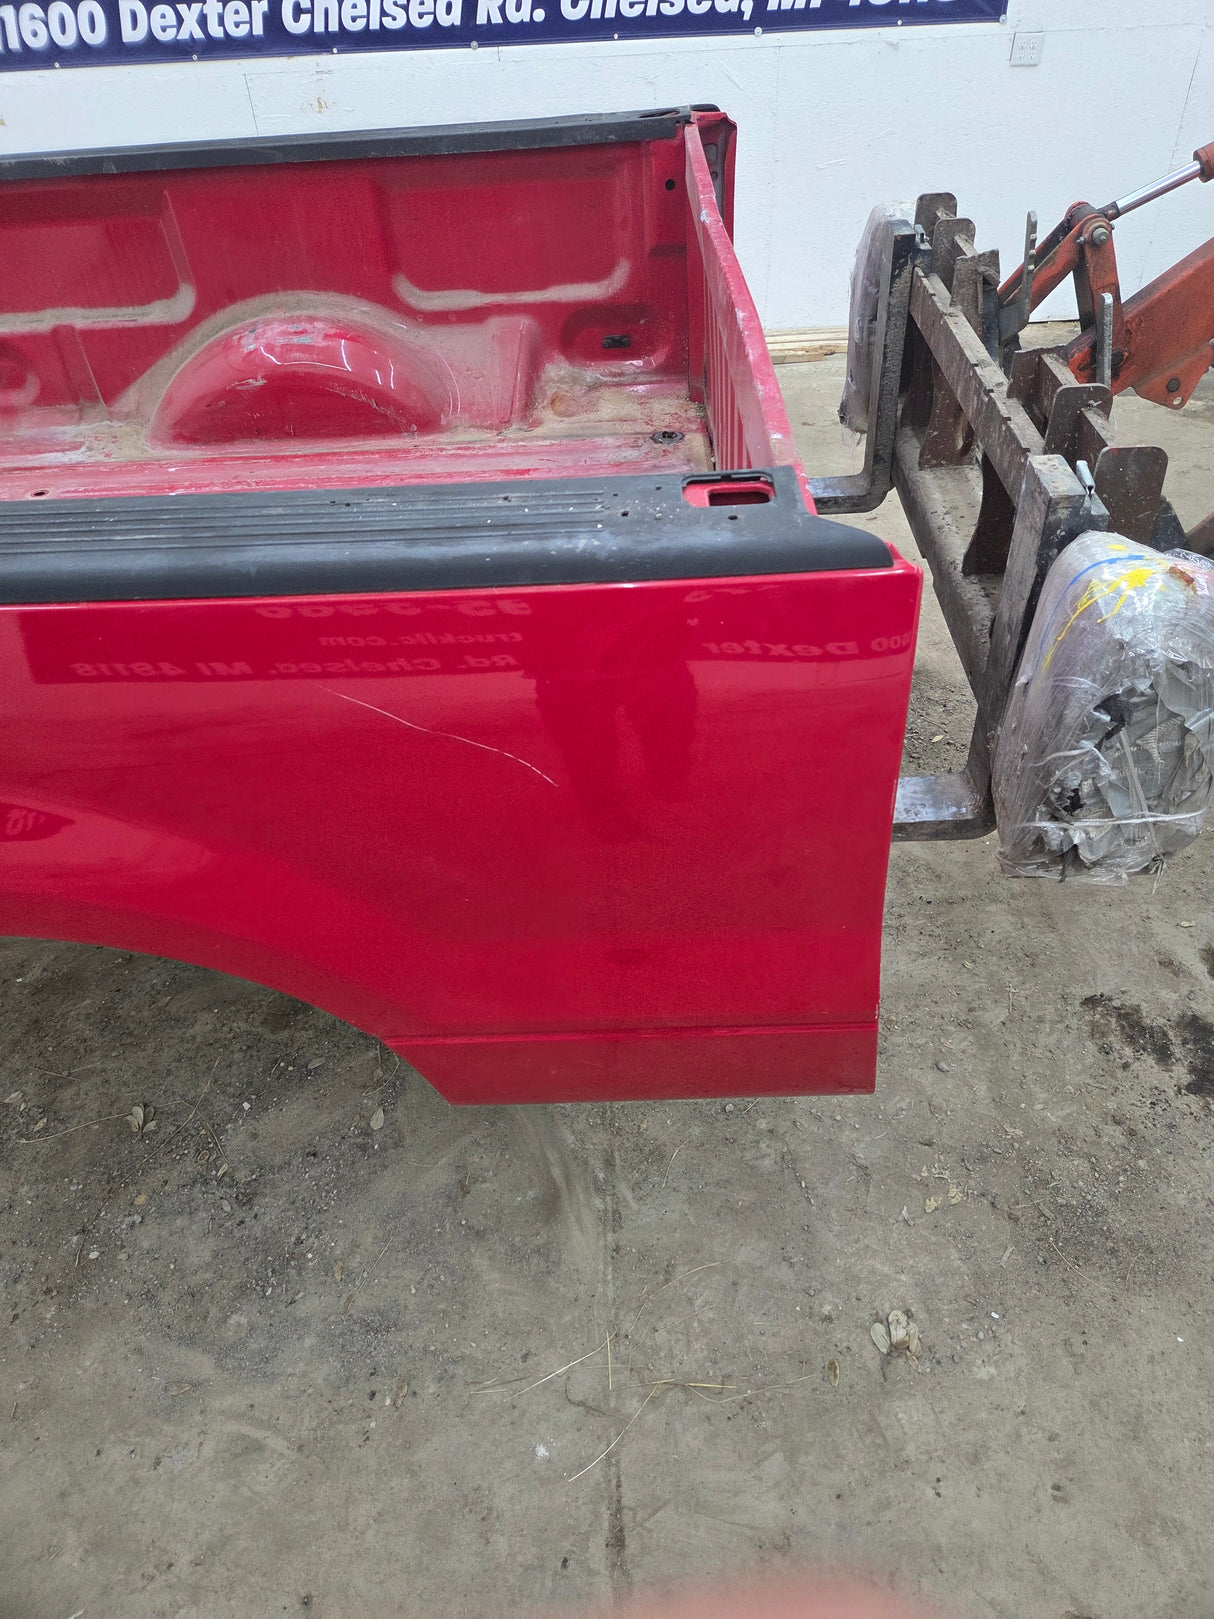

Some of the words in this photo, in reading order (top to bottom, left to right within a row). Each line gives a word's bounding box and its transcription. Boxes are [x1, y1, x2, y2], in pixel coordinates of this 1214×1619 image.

[0, 2, 107, 53] 1600
[118, 0, 268, 43] Dexter
[281, 0, 462, 34] Chelsea
